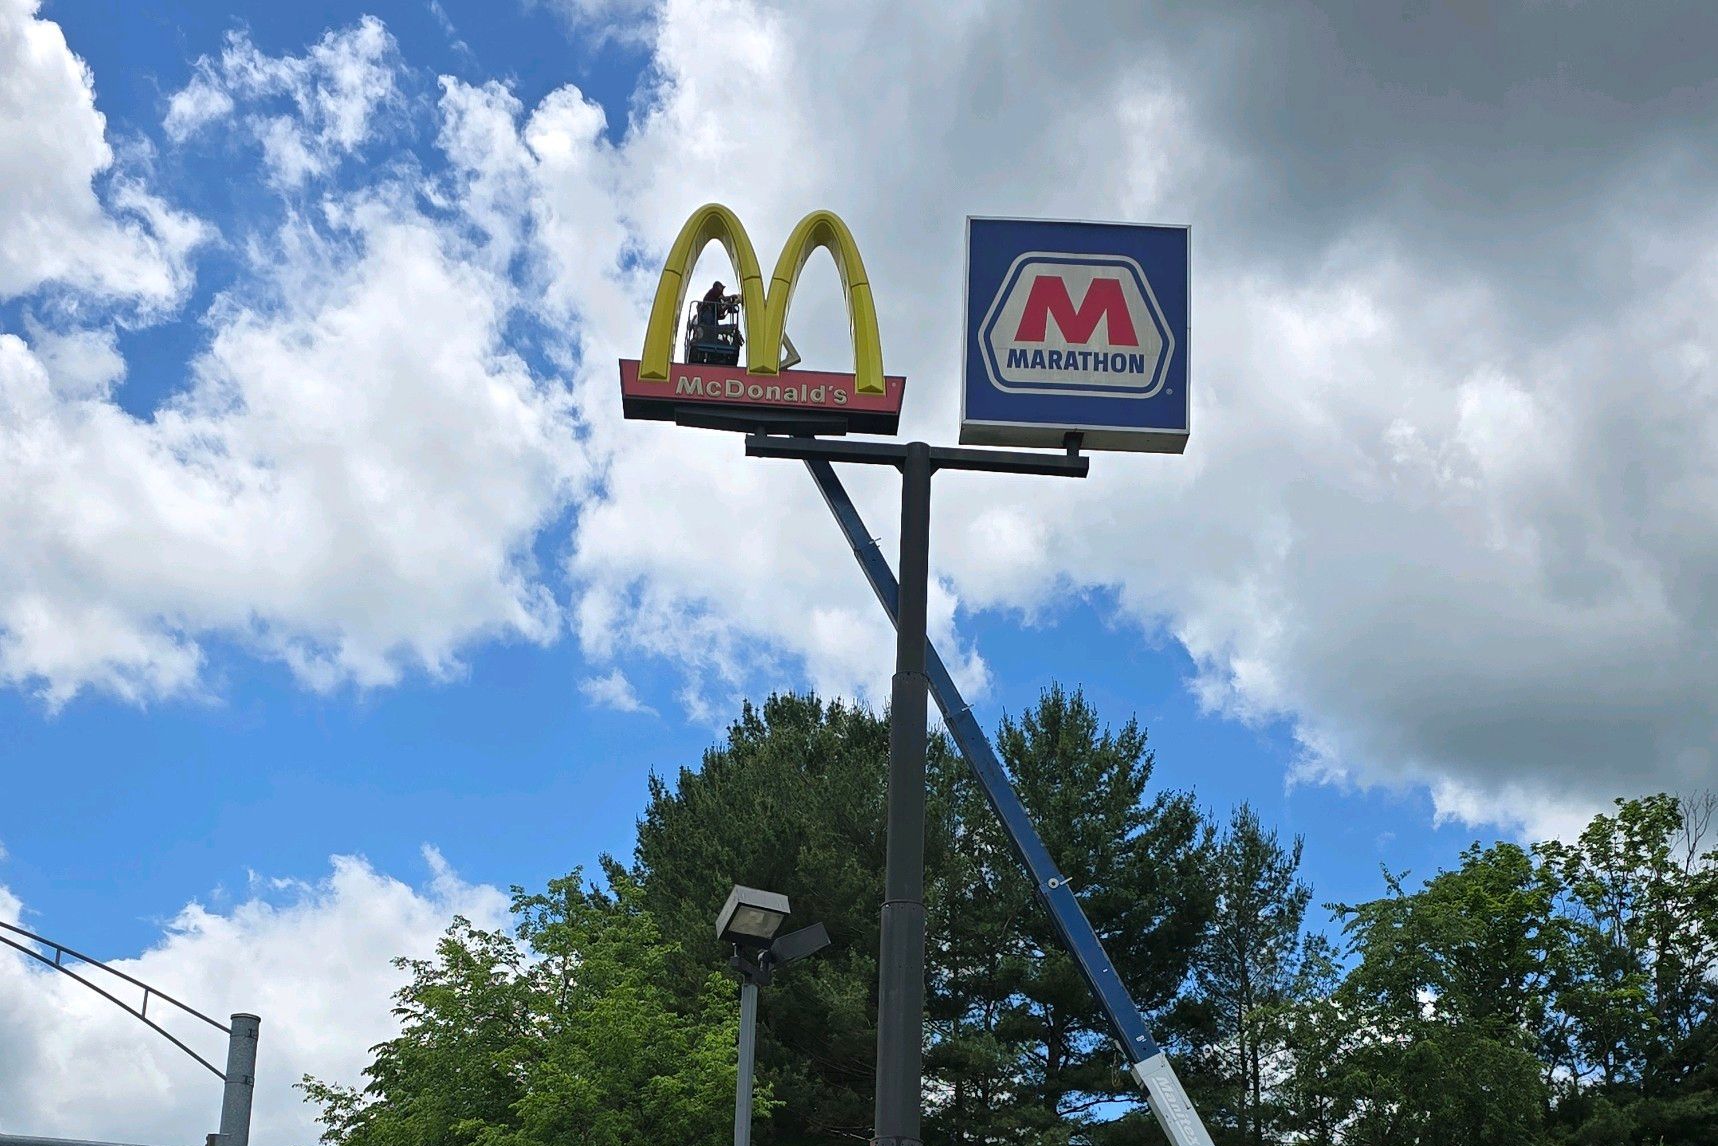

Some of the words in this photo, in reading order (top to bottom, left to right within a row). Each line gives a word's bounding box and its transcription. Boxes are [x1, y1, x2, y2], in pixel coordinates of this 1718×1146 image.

[1014, 275, 1139, 347] M
[1006, 348, 1145, 374] MARATHON
[675, 375, 848, 405] McDonald's
